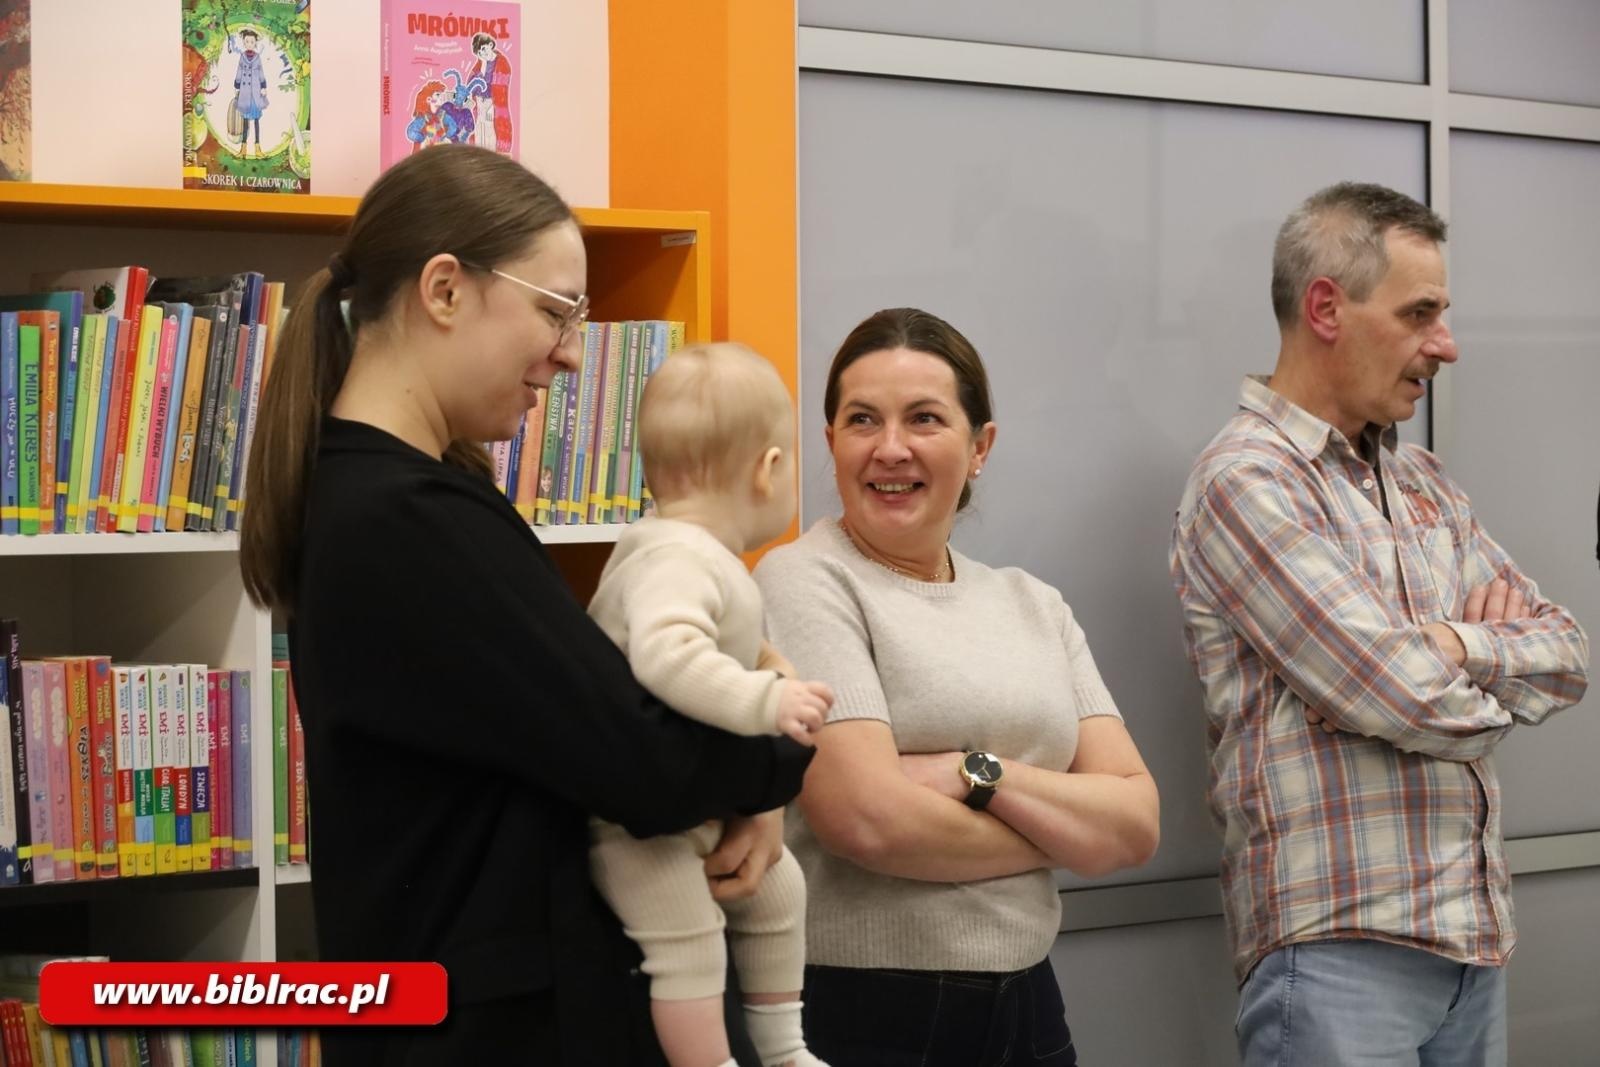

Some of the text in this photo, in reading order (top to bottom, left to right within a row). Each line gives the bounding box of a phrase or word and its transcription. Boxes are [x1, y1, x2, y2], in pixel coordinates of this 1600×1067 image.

[407, 12, 510, 39] MRÓWKI
[202, 173, 238, 187] SKOREK
[246, 176, 302, 190] CZAROWNICA
[24, 362, 38, 406] EMILIA
[152, 386, 168, 459] WIELKI WYBUCH
[567, 408, 577, 441] Karo
[178, 774, 188, 809] LONDYN
[196, 771, 207, 808] SZWECJA
